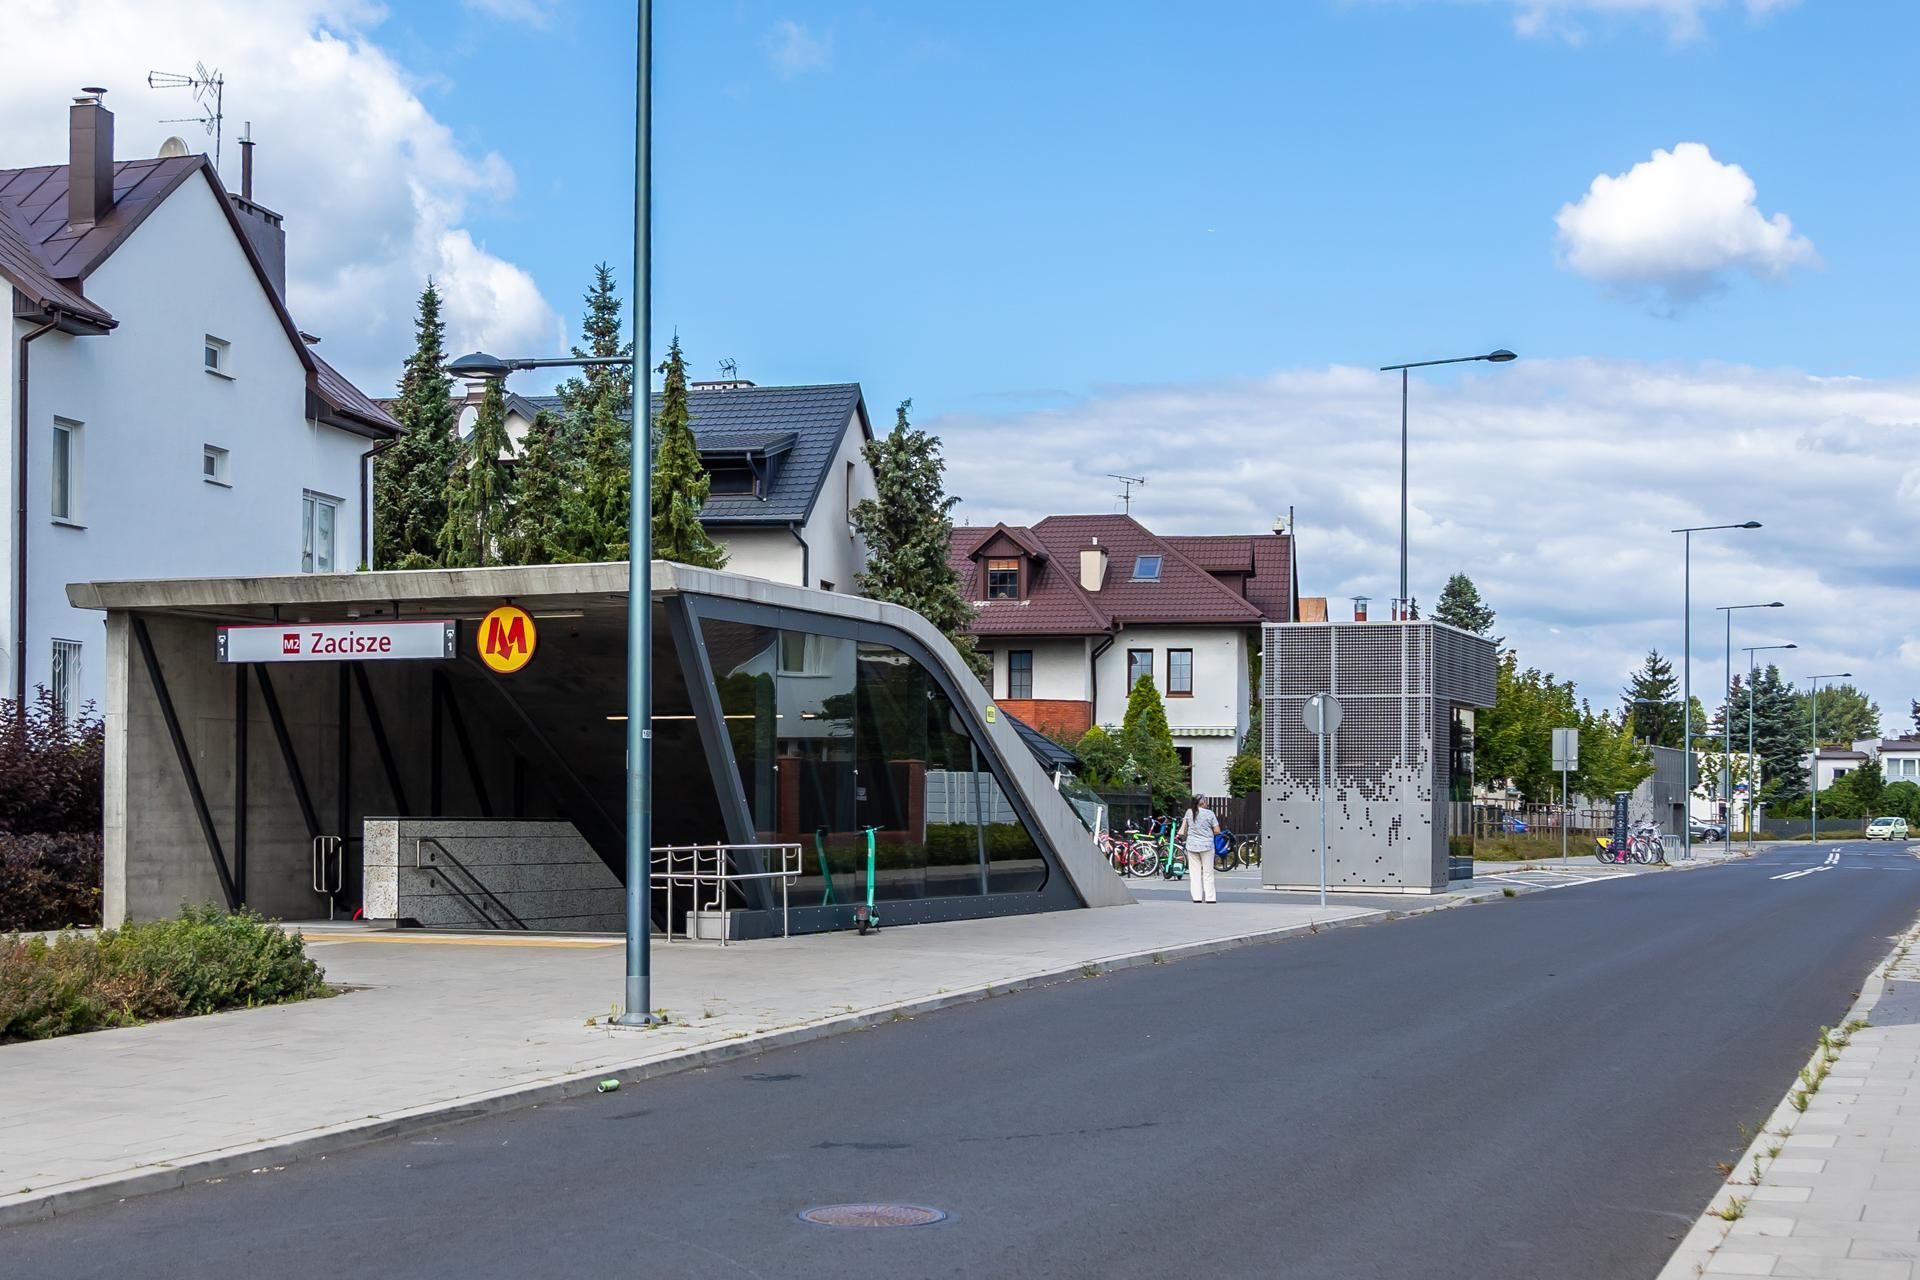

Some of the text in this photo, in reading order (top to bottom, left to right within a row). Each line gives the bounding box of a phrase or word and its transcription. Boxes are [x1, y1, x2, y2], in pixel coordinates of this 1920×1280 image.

[284, 631, 391, 654] M2 Zacisze
[447, 641, 452, 651] 1
[219, 647, 225, 656] 1
